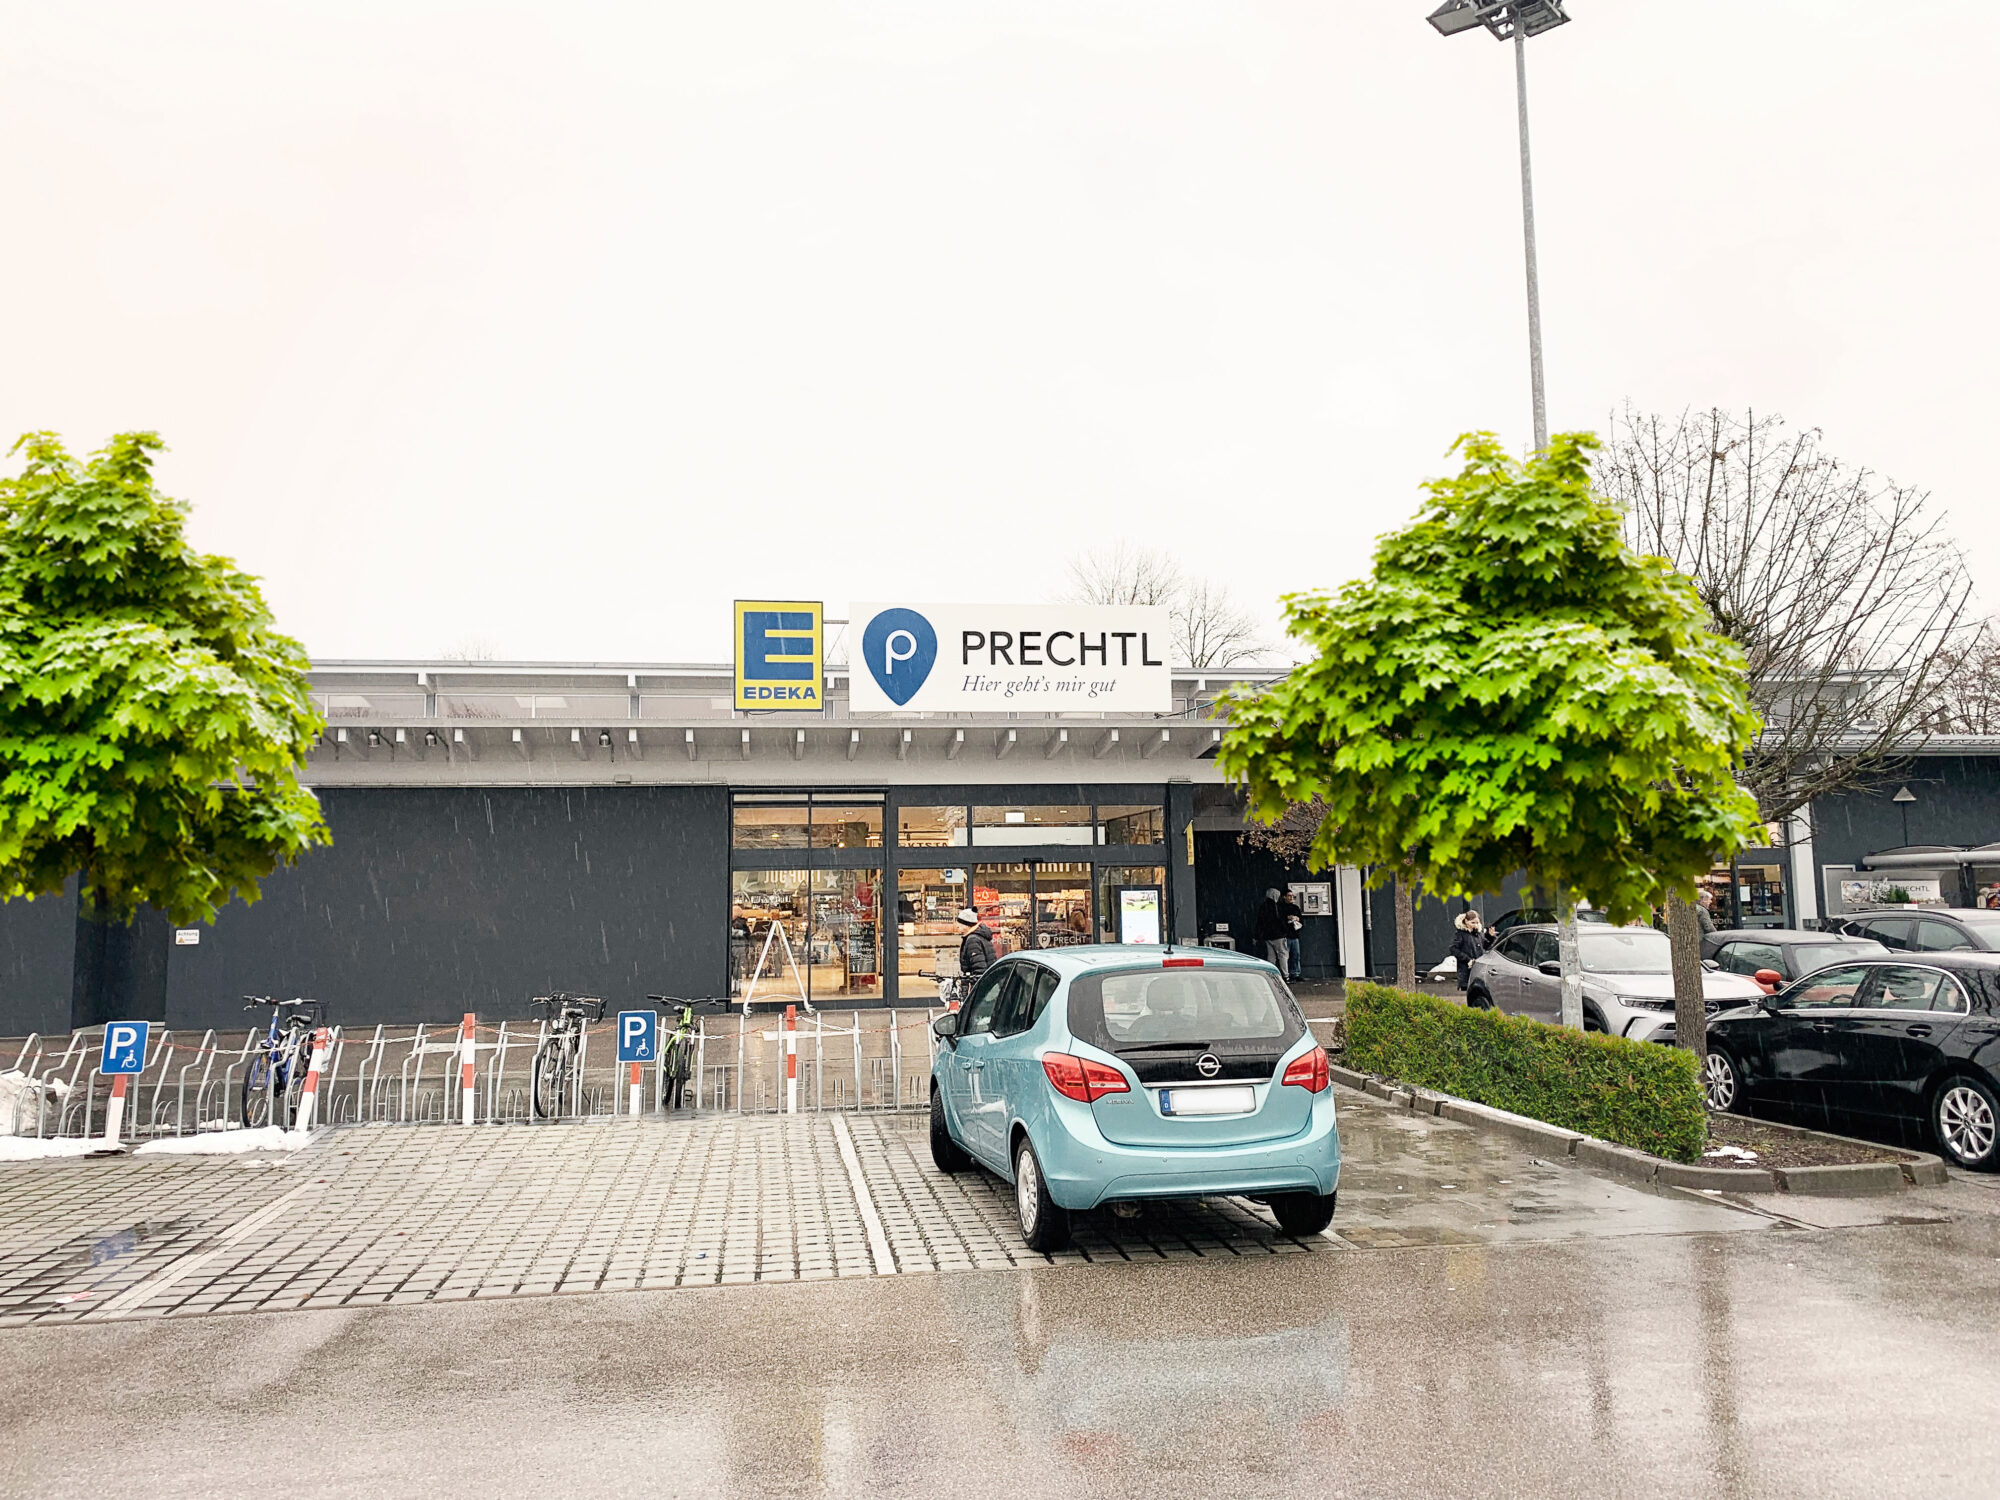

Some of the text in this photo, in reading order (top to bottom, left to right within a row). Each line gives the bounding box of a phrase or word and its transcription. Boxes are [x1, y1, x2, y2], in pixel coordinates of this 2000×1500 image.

[962, 631, 1163, 667] PRECHTL
[744, 687, 817, 700] EDEKA
[961, 675, 1002, 692] Hier
[1055, 675, 1086, 692] mir
[1088, 678, 1118, 698] gut
[109, 1027, 137, 1059] P
[624, 1016, 647, 1048] P
